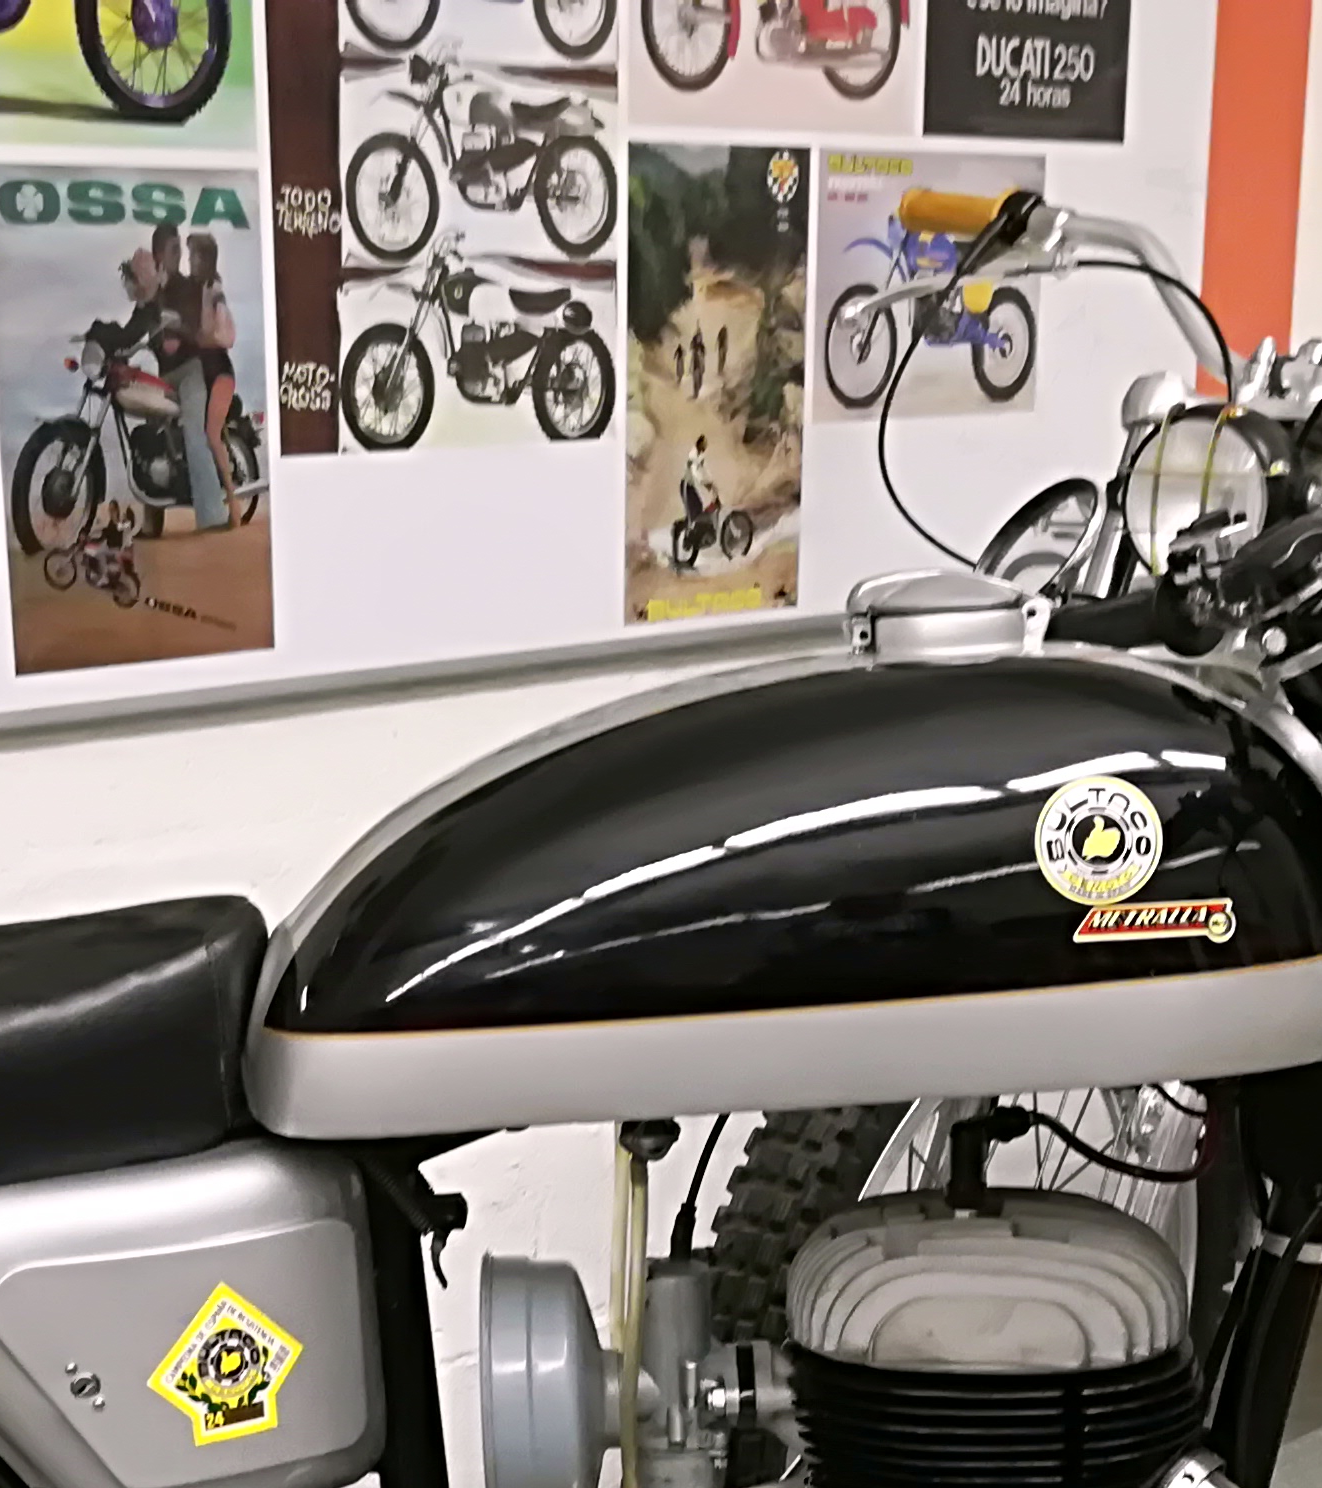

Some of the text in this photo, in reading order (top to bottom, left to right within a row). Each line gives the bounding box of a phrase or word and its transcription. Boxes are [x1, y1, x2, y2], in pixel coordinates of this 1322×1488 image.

[976, 32, 1095, 82] DUCATI 250
[999, 76, 1072, 109] 24 horas
[280, 184, 332, 212] TODO
[1046, 788, 1152, 862] BULTACO
